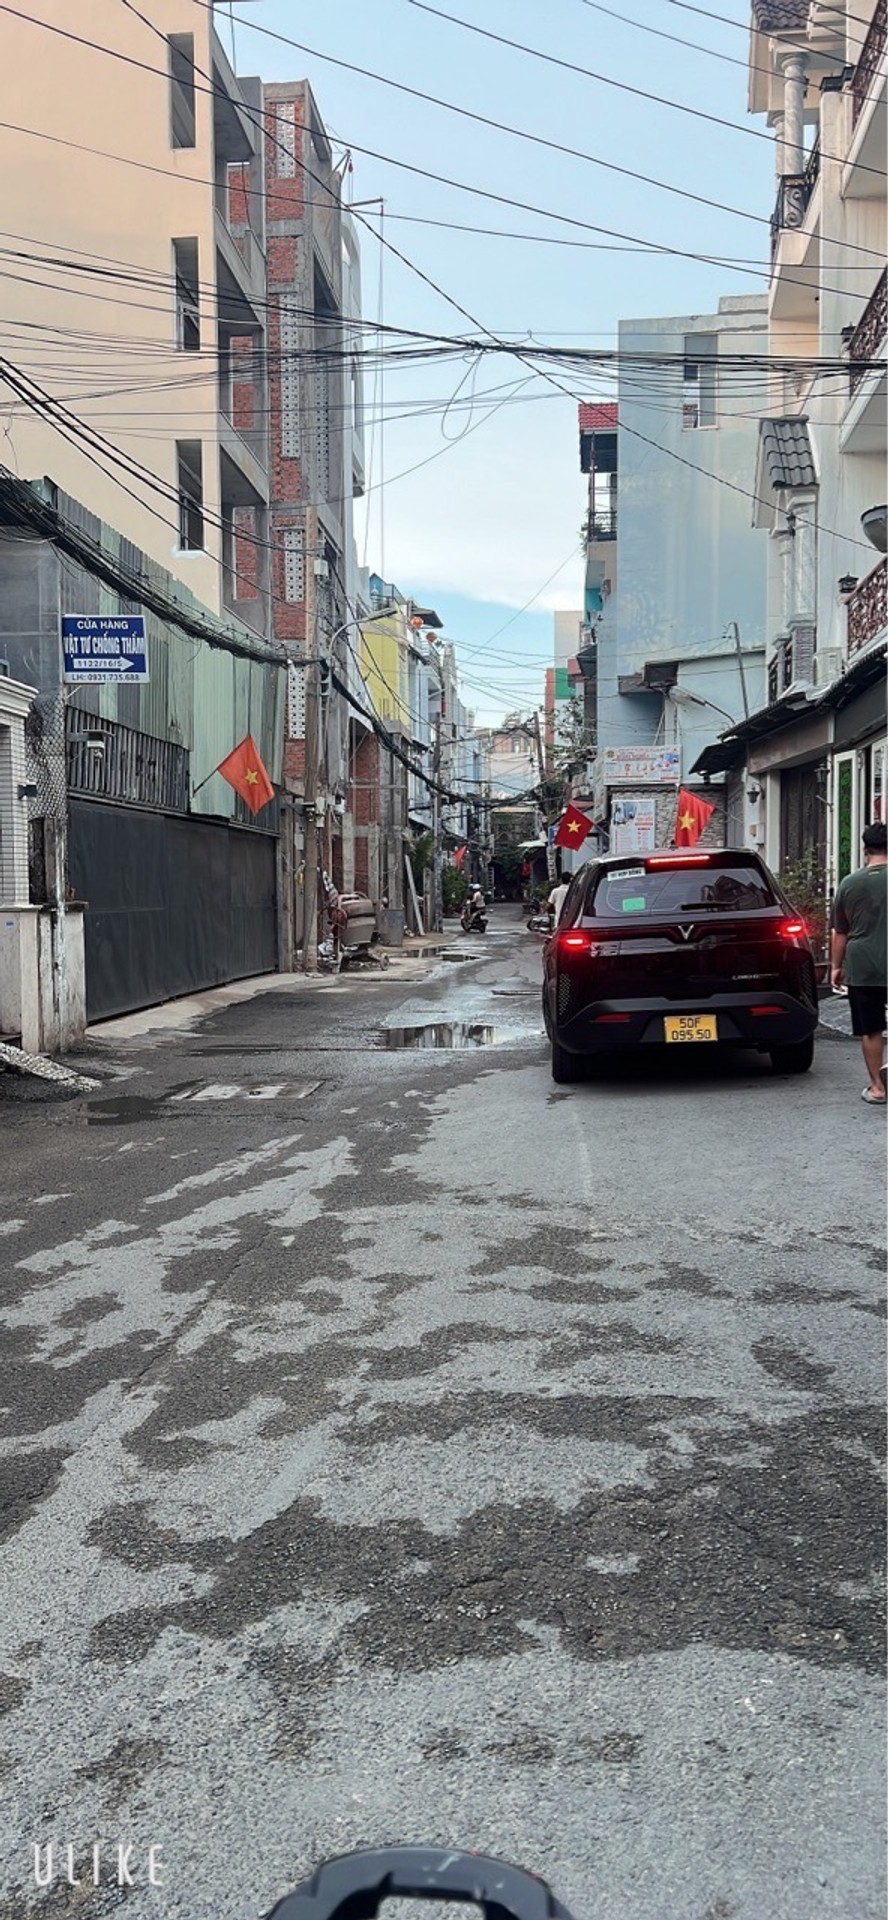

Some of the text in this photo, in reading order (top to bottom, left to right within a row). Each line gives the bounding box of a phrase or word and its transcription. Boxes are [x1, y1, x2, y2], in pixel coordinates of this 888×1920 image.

[76, 618, 128, 630] CỬA HÀNG
[63, 631, 145, 658] VẬT TƯ CHỐNG THẤM
[77, 659, 123, 668] 1122/16/5
[679, 1017, 701, 1029] 50F
